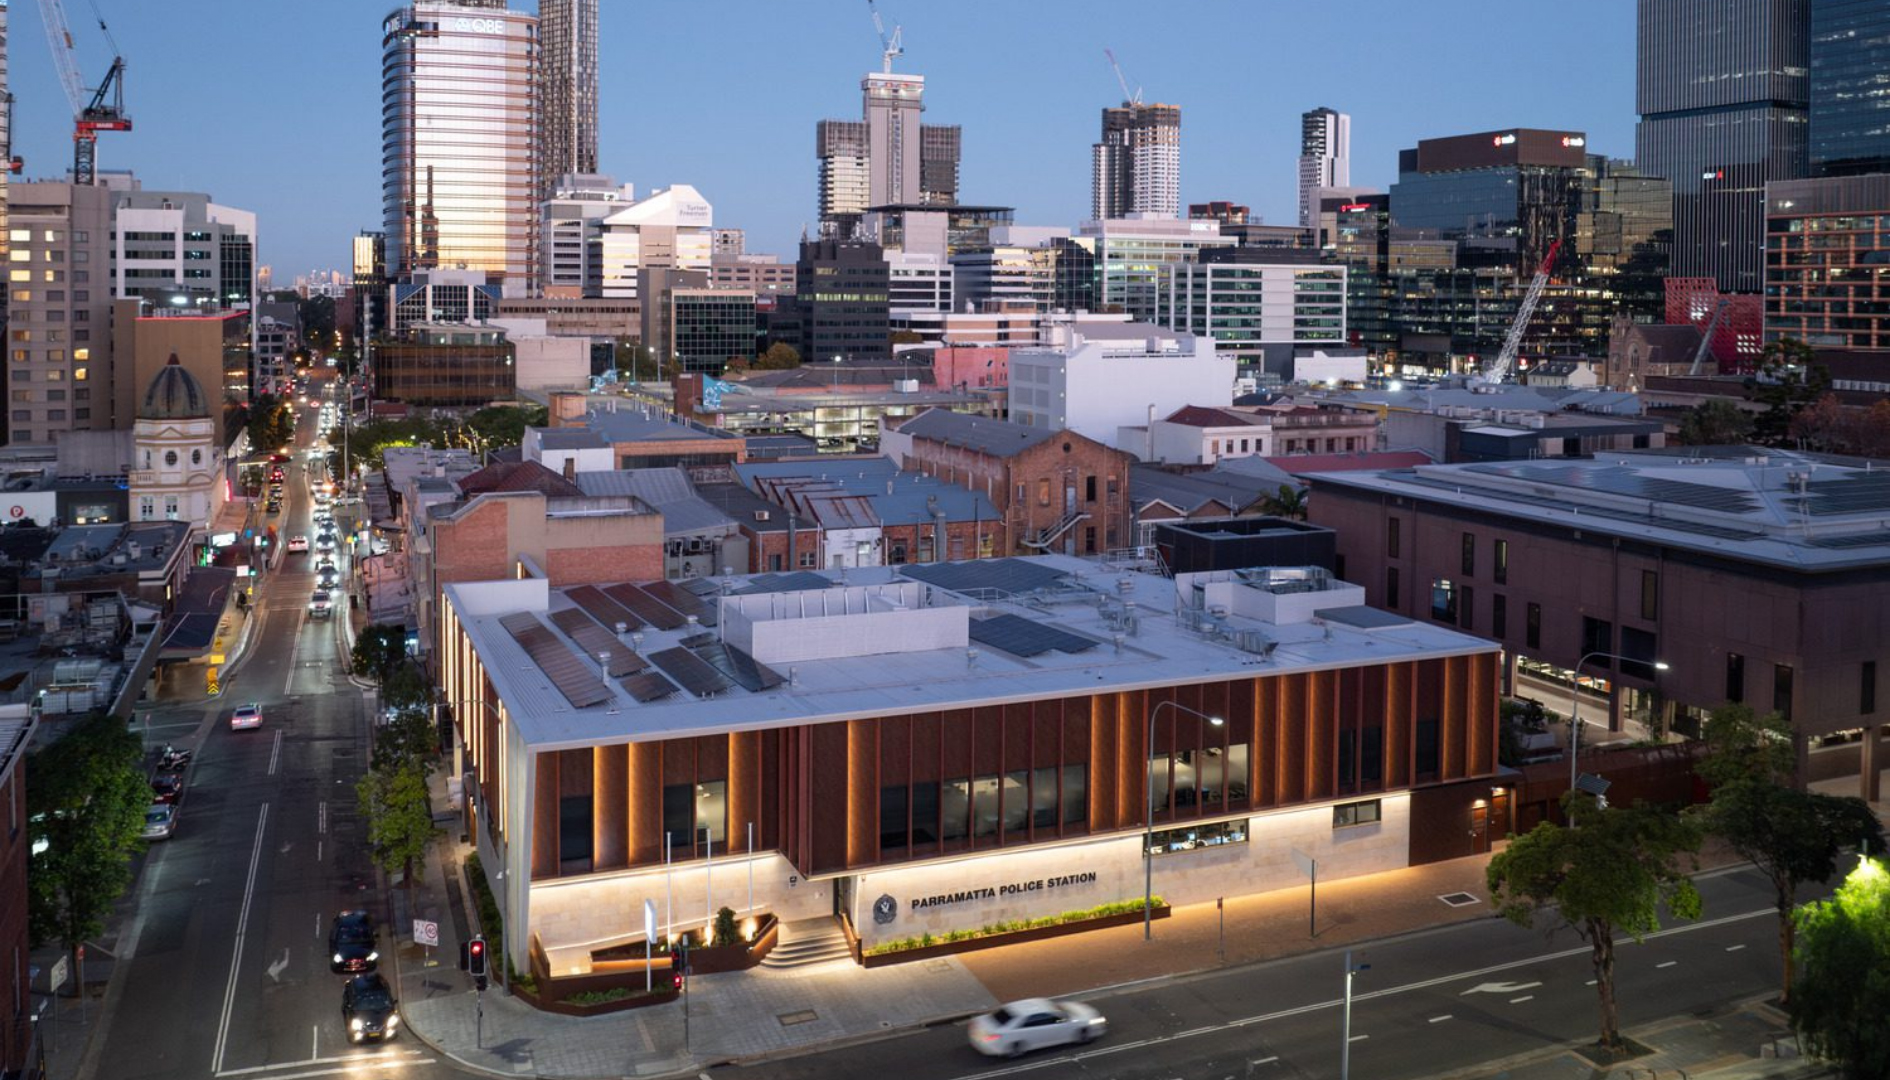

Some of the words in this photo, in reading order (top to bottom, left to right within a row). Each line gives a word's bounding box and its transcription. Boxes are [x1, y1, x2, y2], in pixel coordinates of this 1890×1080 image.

[473, 18, 504, 34] QBE
[912, 889, 995, 908] PARRAMATTA
[1000, 880, 1044, 895] POLICE
[1048, 872, 1096, 888] STATION
